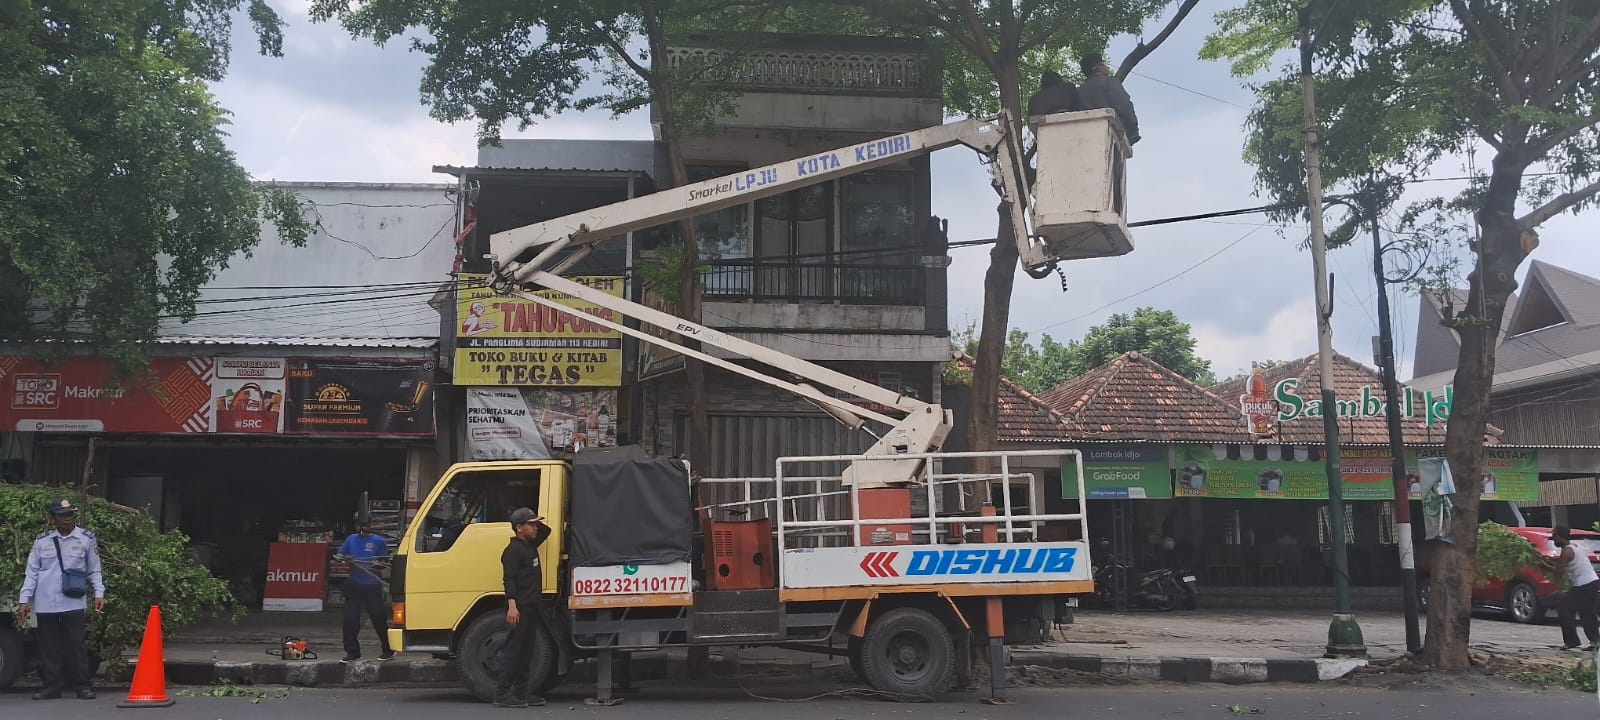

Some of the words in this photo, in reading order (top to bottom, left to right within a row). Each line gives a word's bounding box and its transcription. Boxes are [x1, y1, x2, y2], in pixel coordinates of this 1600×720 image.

[688, 180, 732, 202] Snorkel
[735, 168, 777, 191] LPJU
[796, 153, 840, 177] KOTA
[855, 134, 912, 162] KEDIRI
[676, 323, 700, 335] EPV
[469, 339, 481, 347] JL.
[484, 339, 523, 347] PANGLIMA
[526, 339, 567, 347] SUDIRMAN
[569, 339, 580, 347] 113
[583, 339, 608, 347] KEDIRI
[469, 352, 505, 362] TOKO
[510, 352, 547, 362] BUKU
[552, 352, 563, 362] &
[567, 352, 607, 363] KITAB
[496, 365, 580, 384] TEGAS
[17, 379, 55, 391] TOKO
[26, 392, 55, 405] SRC
[322, 391, 343, 399] 234
[1274, 377, 1413, 421] Sambl
[468, 407, 525, 416] PRIORITASKAN
[1246, 401, 1273, 413] pucuk
[242, 419, 262, 428] SRC
[468, 416, 505, 424] SEHATMU
[1125, 450, 1140, 460] Idjo
[1416, 449, 1446, 458] PAKE
[1093, 471, 1140, 481] GrabFood
[905, 547, 1078, 575] DISHUB
[575, 579, 611, 594] 0822
[614, 577, 687, 592] 32110177
